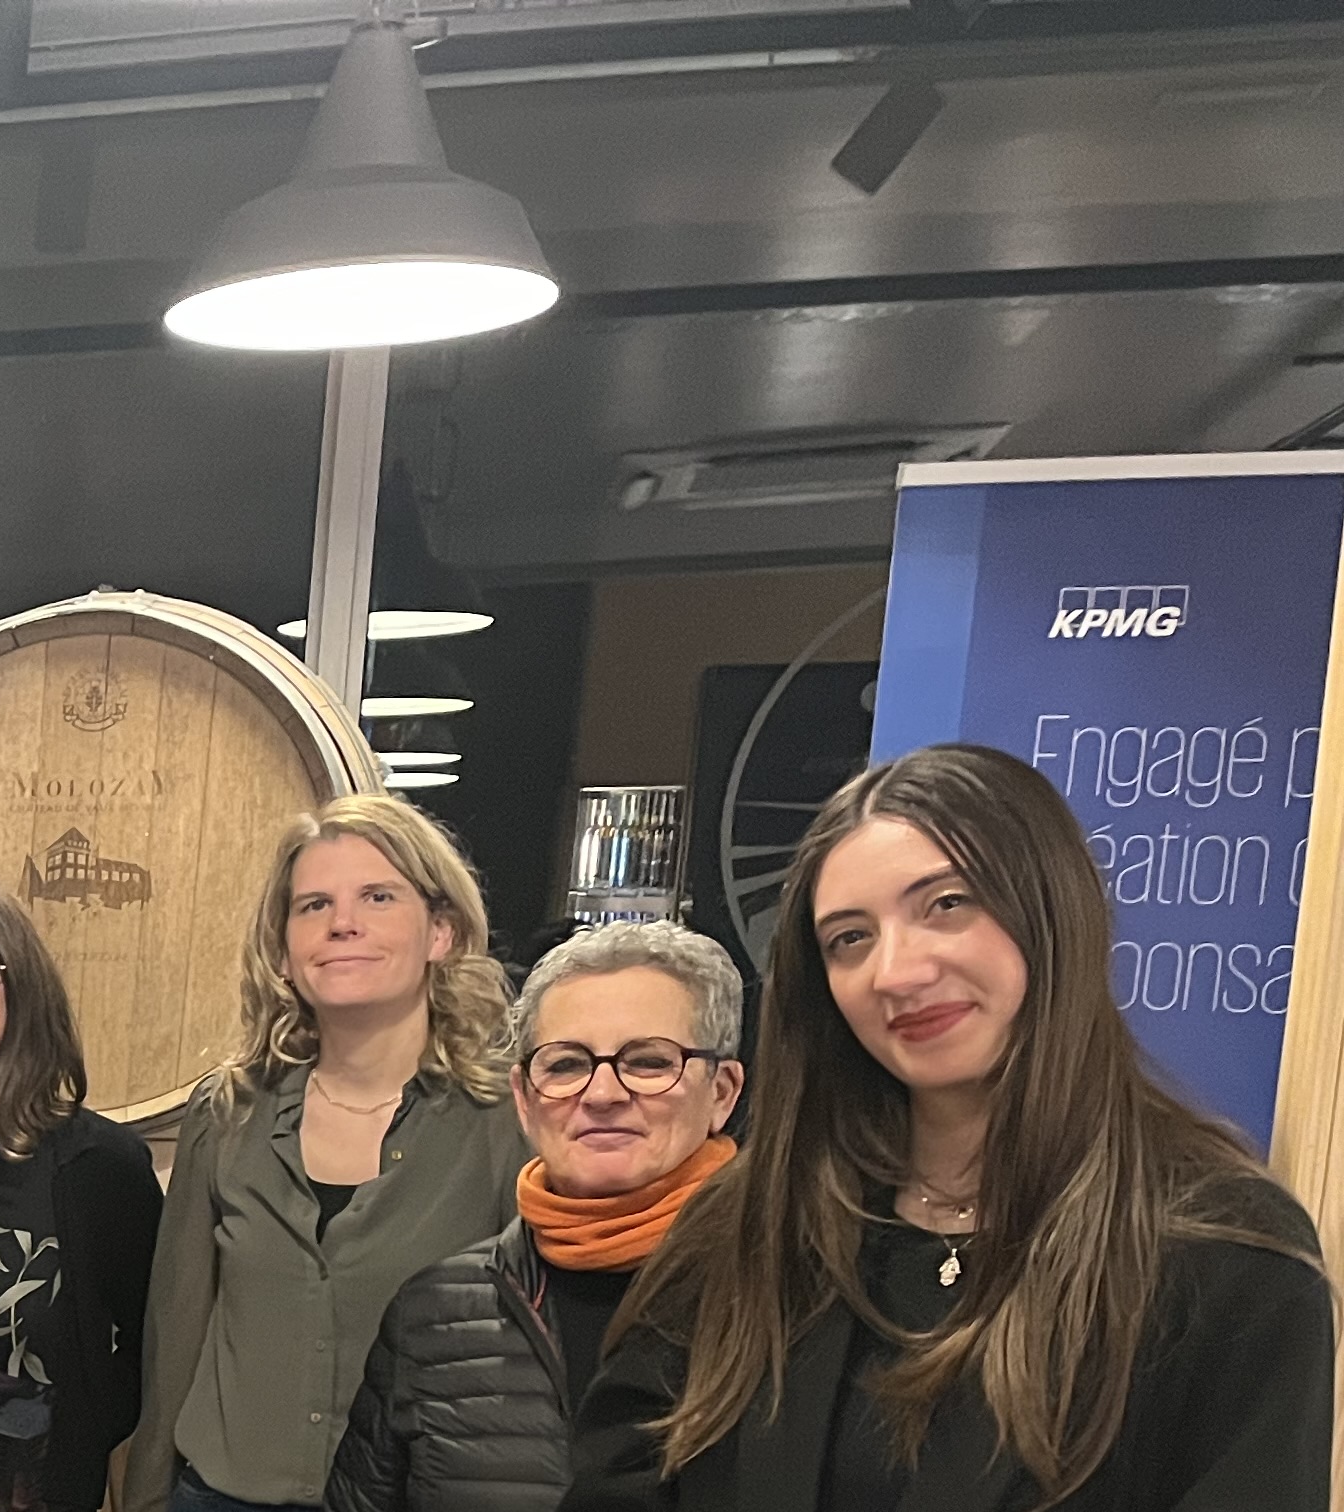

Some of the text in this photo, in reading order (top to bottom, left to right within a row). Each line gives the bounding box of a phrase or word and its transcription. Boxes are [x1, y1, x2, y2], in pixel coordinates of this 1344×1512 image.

[1049, 606, 1183, 639] KPMG
[1032, 714, 1268, 808] Engagé
[1085, 823, 1270, 906] éation
